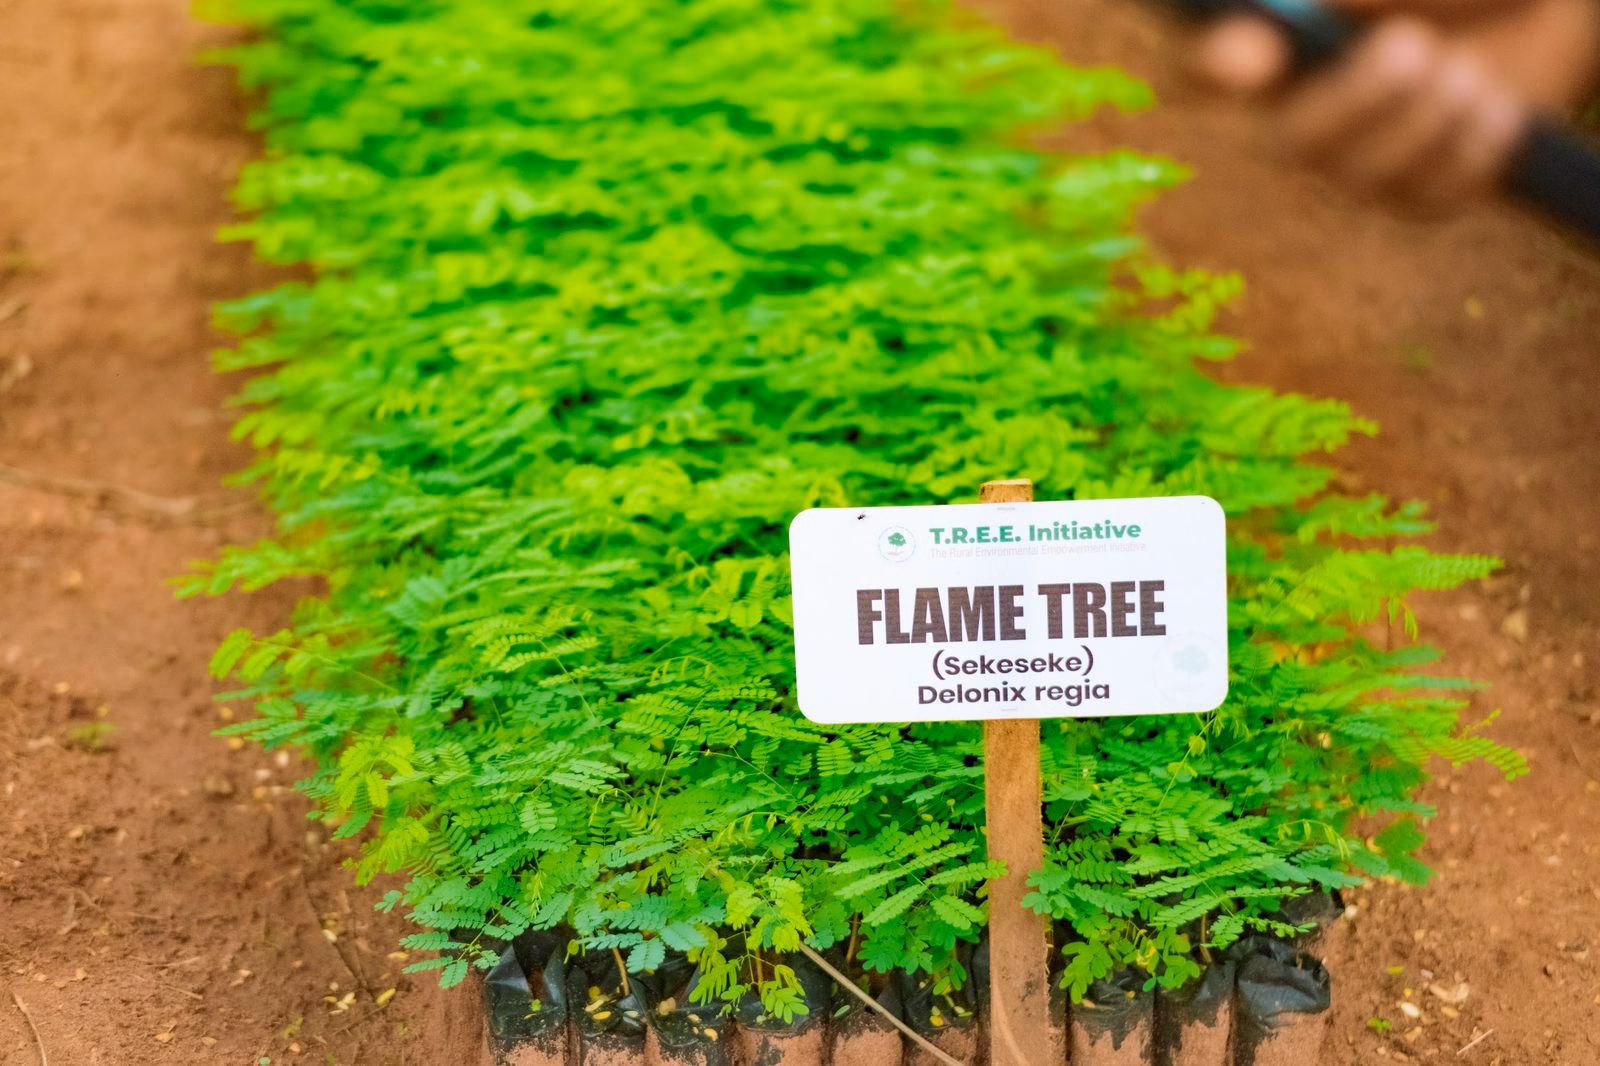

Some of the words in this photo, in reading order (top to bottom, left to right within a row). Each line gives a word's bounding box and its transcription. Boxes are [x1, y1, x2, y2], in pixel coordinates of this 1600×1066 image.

[929, 526, 1022, 545] T.R.E.E.
[1029, 519, 1142, 542] Initiative
[930, 548, 948, 560] The
[950, 546, 974, 559] Rural
[975, 545, 1039, 558] Environmental
[1041, 543, 1107, 557] Empowerment
[856, 584, 1027, 646] FLAME
[1037, 579, 1167, 639] TREE
[932, 645, 1095, 680] (Sekeseke)
[918, 681, 1027, 705] Delonix
[1034, 680, 1110, 707] regia
